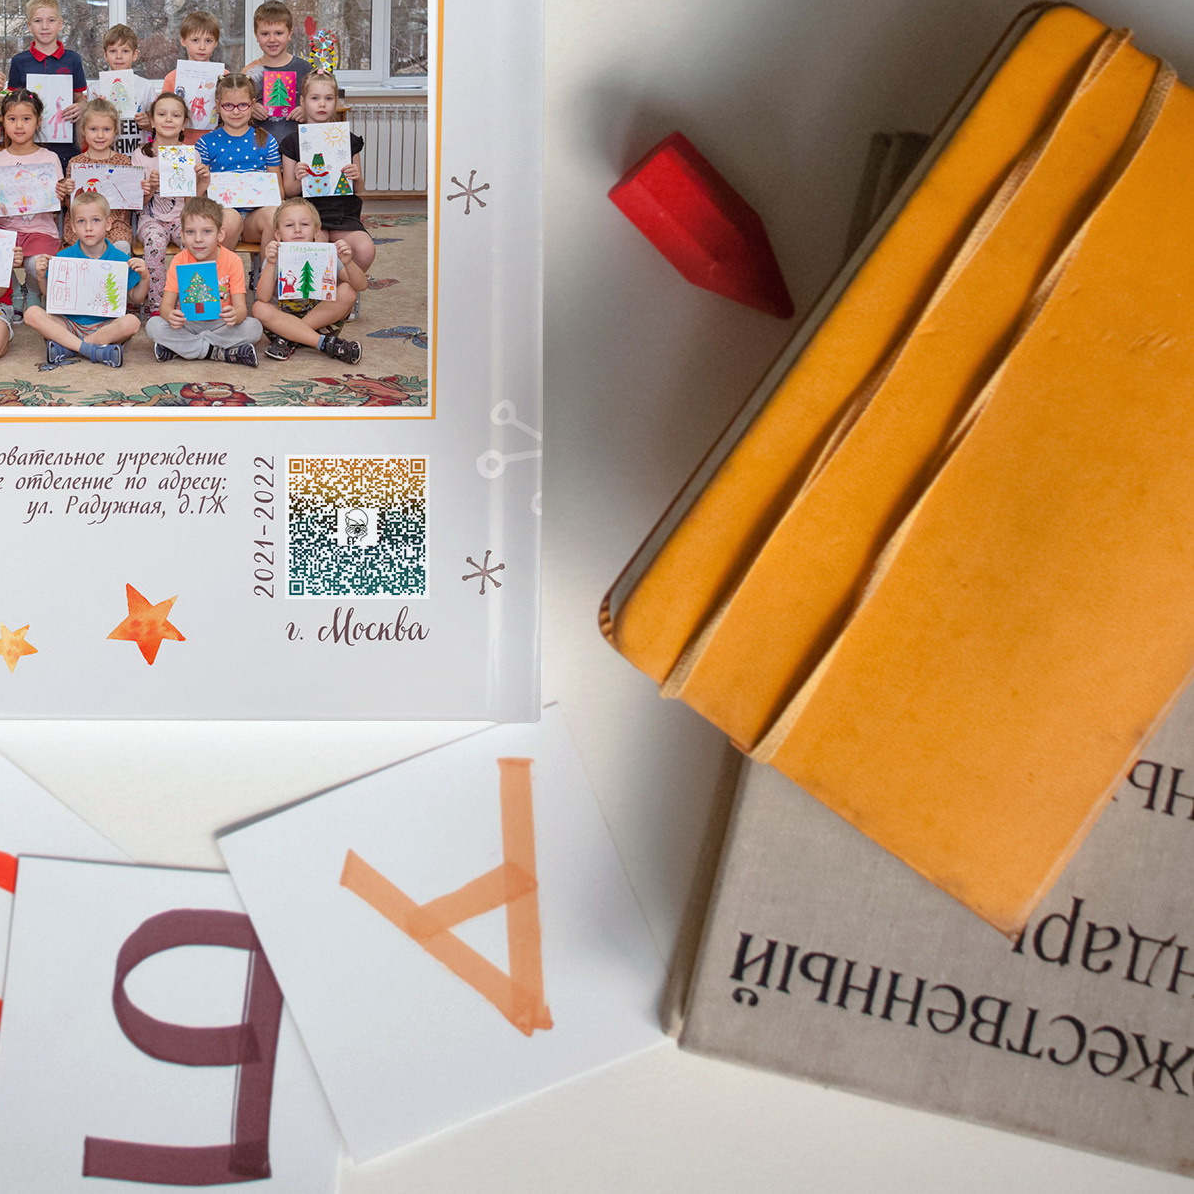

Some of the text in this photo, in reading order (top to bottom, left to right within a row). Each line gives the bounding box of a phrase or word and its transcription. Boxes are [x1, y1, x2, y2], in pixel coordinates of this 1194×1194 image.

[112, 445, 228, 476] учреждение
[15, 469, 114, 490] отделение
[124, 476, 147, 490] по
[158, 469, 228, 500] адресу:
[22, 493, 228, 525] ул. Радужная, д.1Ж
[253, 456, 275, 599] 2021-2022
[285, 605, 430, 647] г. Москва
[730, 933, 1194, 1097] жественный
